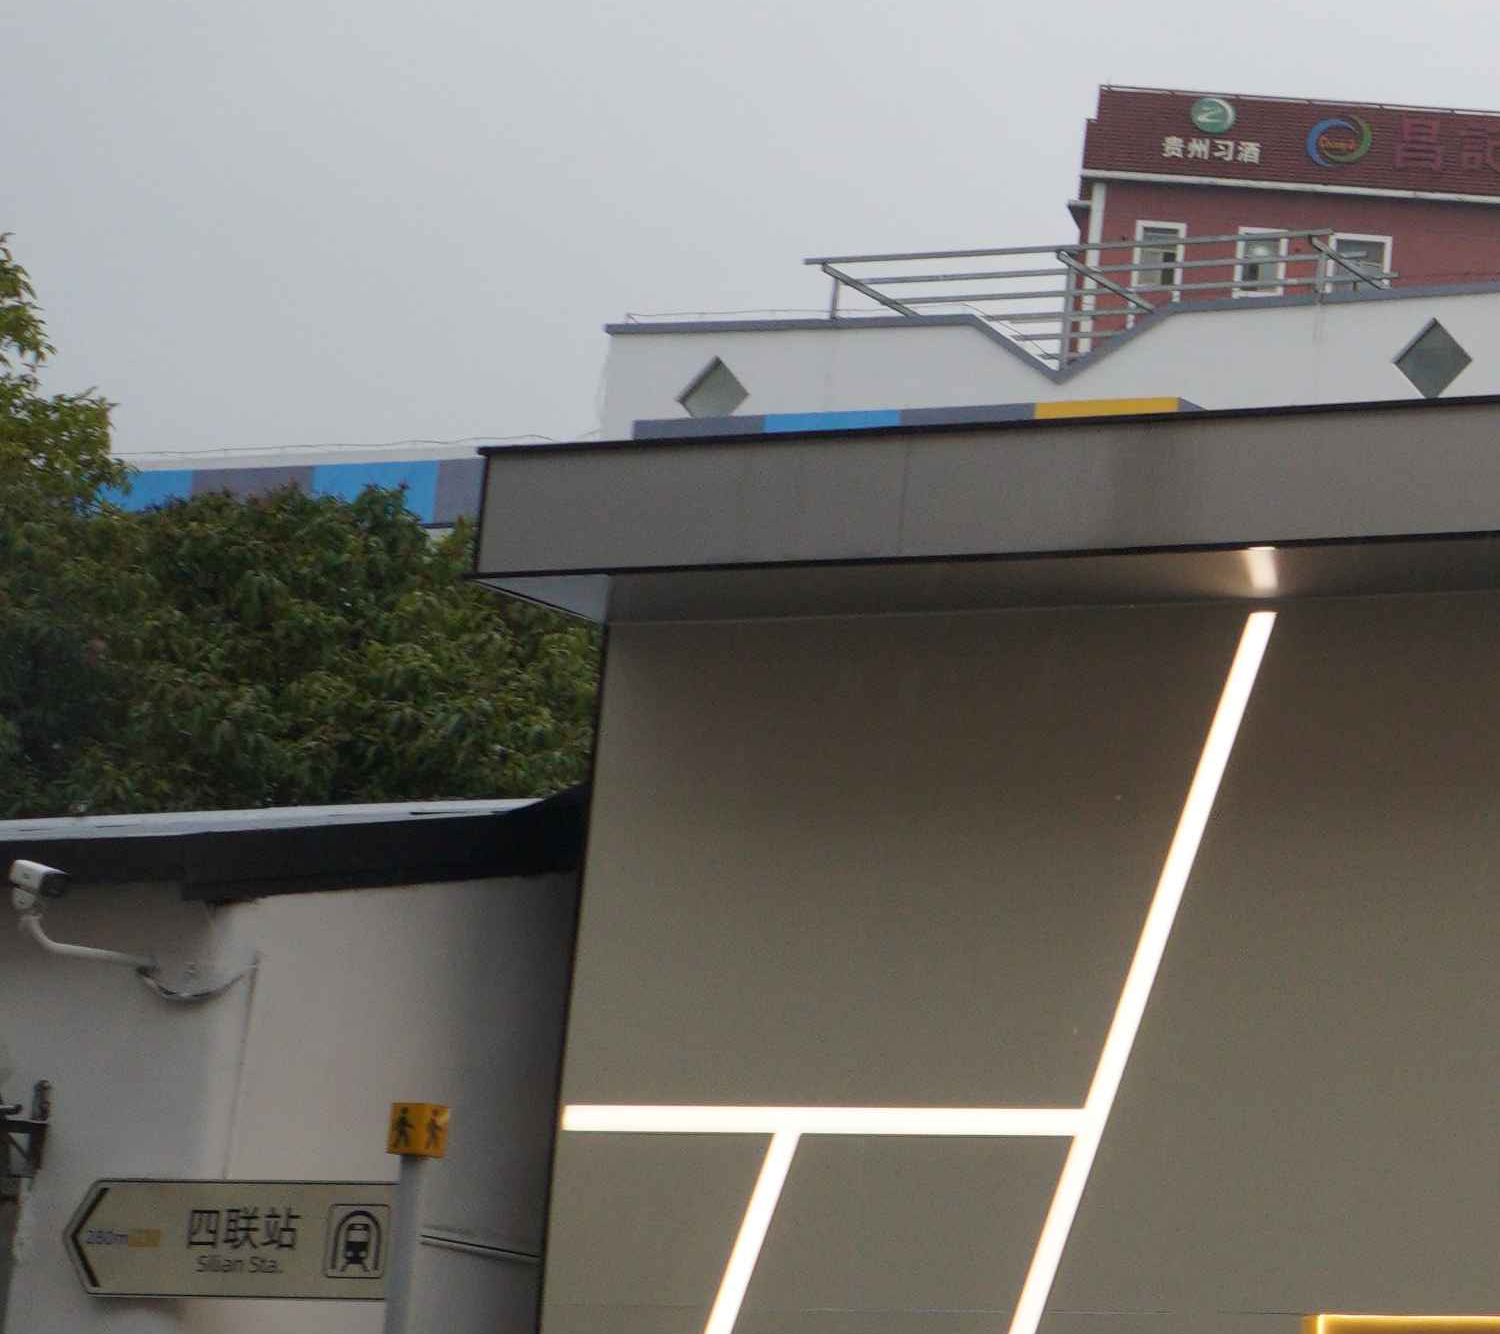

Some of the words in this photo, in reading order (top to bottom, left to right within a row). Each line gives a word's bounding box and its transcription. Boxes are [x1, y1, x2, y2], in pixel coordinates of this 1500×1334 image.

[1161, 135, 1262, 164] 贵州习酒
[187, 1208, 302, 1250] 四联站
